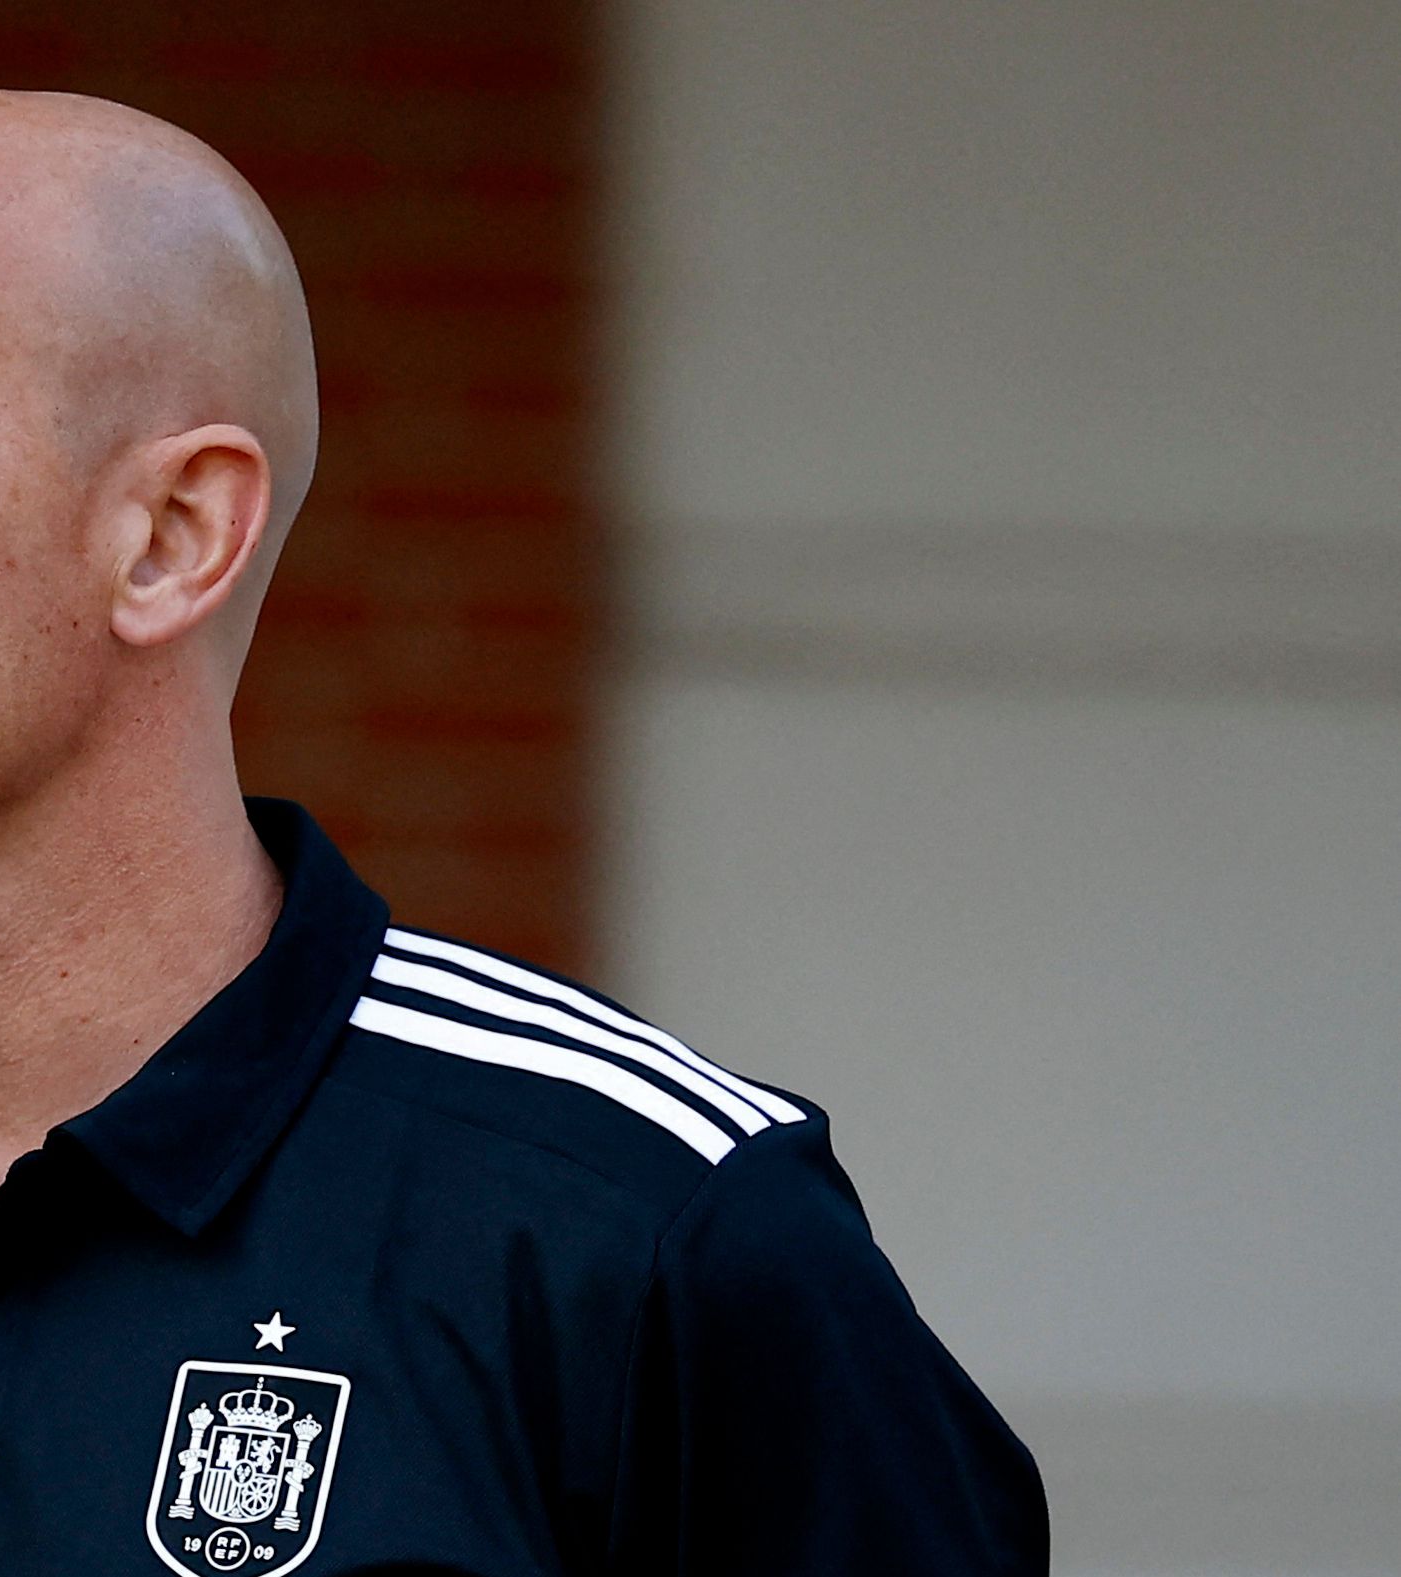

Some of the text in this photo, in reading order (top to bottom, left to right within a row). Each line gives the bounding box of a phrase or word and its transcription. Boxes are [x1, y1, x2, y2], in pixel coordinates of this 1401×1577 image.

[184, 1537, 202, 1552] 19
[217, 1536, 241, 1548] RF
[214, 1548, 239, 1560] EF
[253, 1545, 274, 1560] 09
